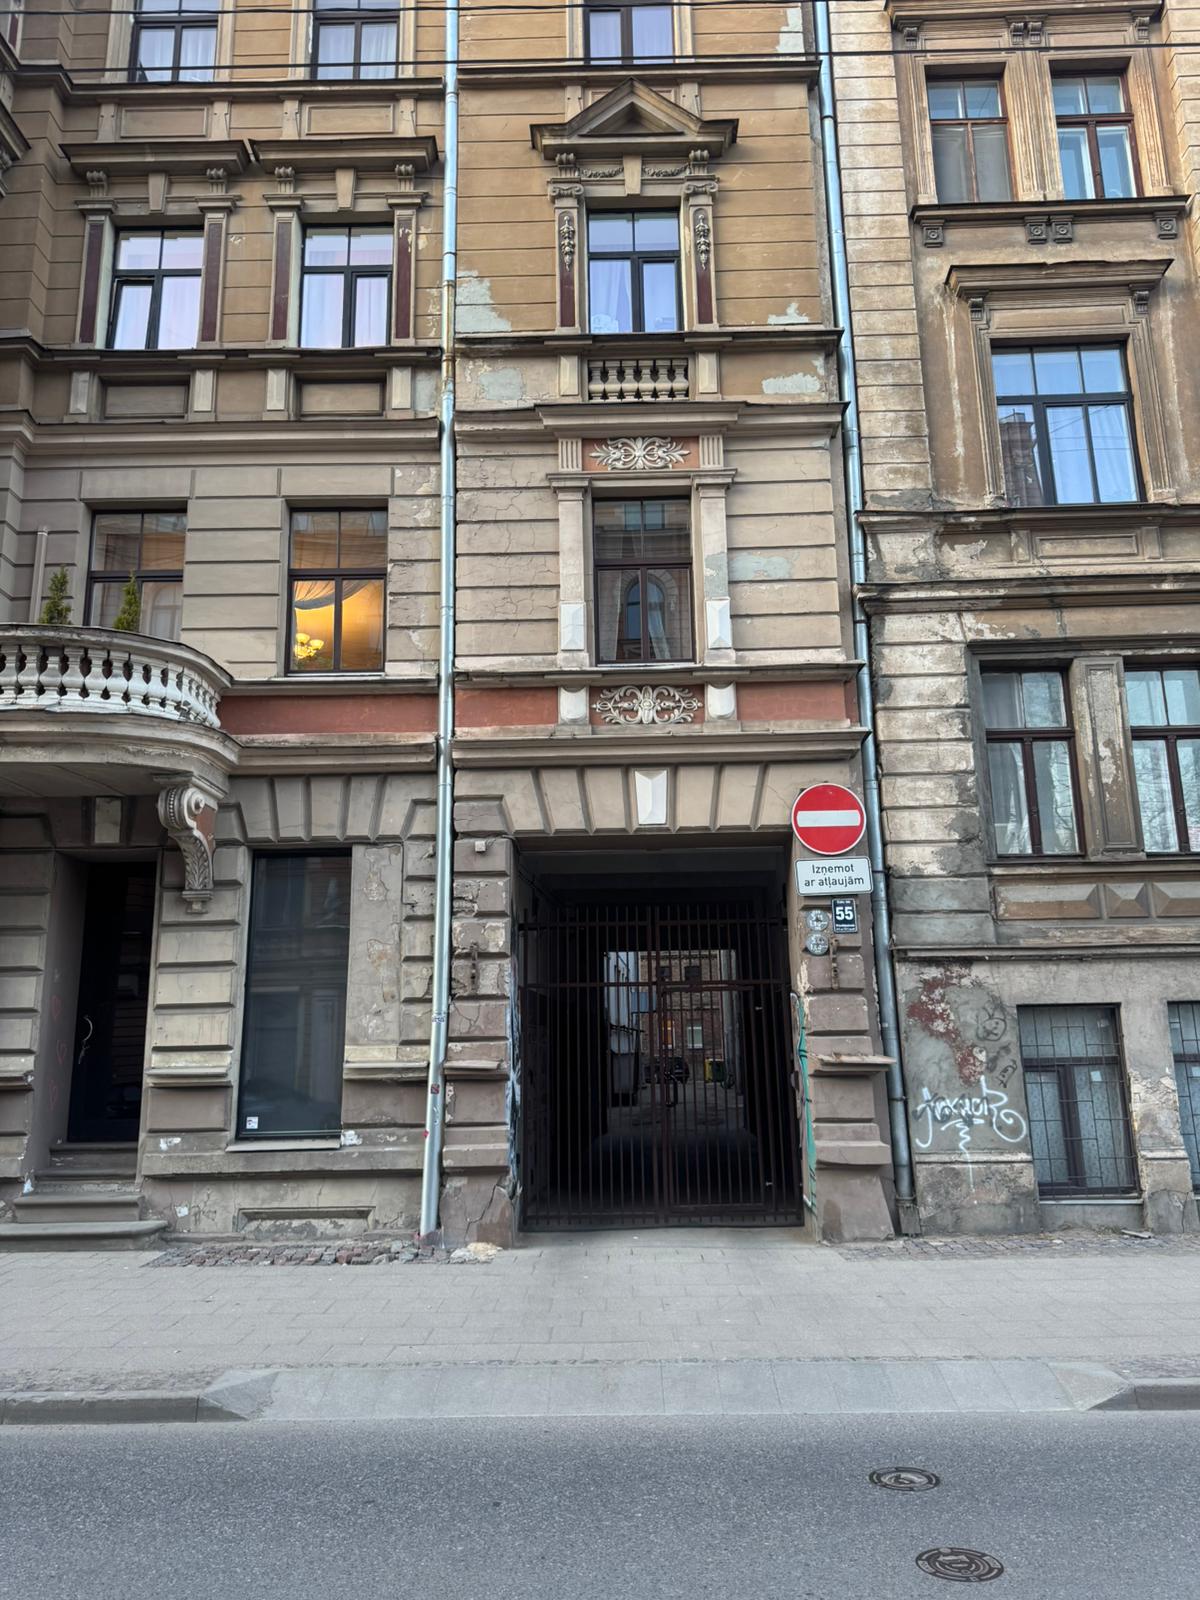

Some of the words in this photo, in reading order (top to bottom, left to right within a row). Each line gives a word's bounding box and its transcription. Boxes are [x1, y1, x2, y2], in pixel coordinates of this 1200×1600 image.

[812, 864, 854, 876] Izņemot
[804, 879, 816, 887] ar
[818, 876, 864, 888] atļaujām
[835, 906, 854, 920] 55
